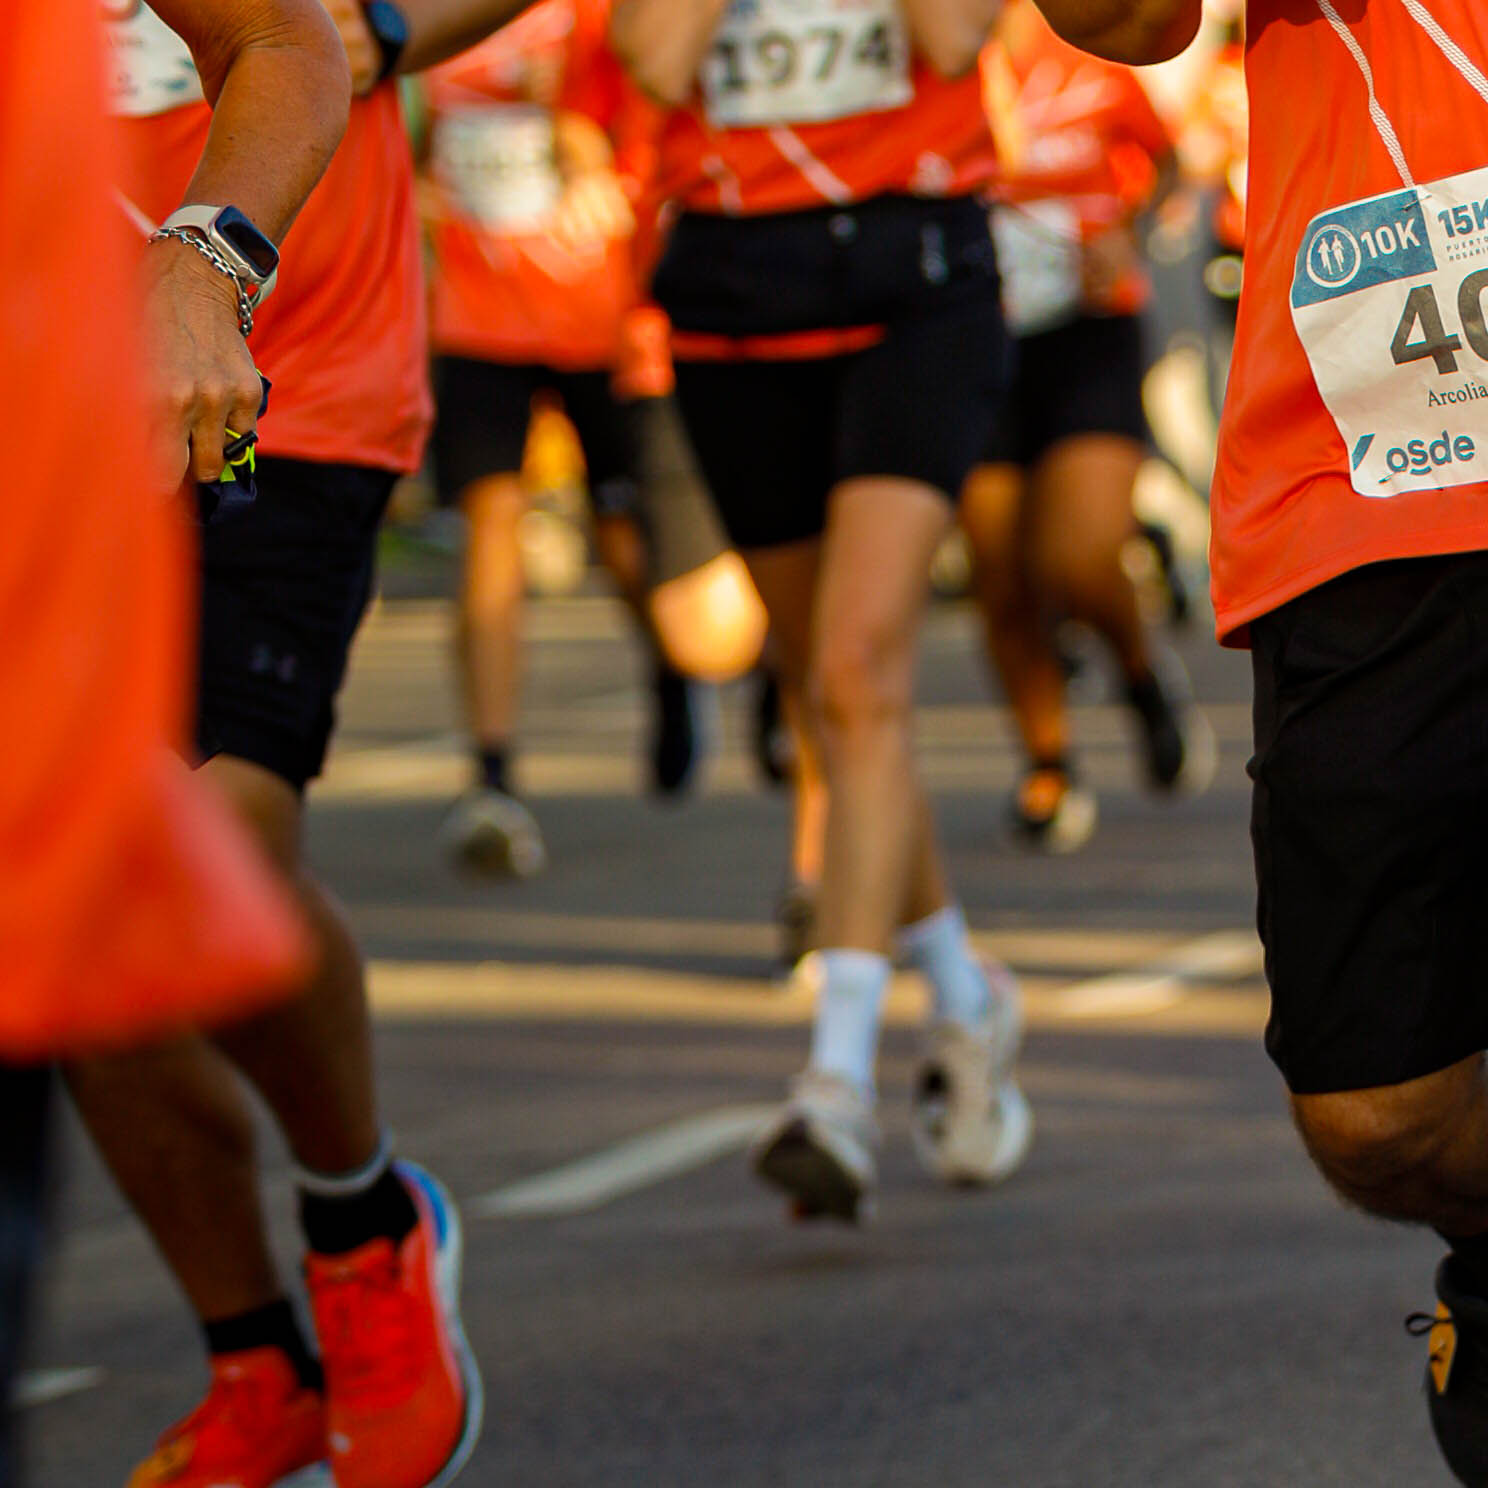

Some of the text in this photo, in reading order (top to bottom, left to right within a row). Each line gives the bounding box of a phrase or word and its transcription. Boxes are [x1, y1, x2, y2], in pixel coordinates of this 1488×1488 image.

[714, 22, 891, 91] 1974
[1360, 218, 1421, 259] 10K
[1428, 381, 1488, 407] Arcolia
[1386, 430, 1475, 474] osde
